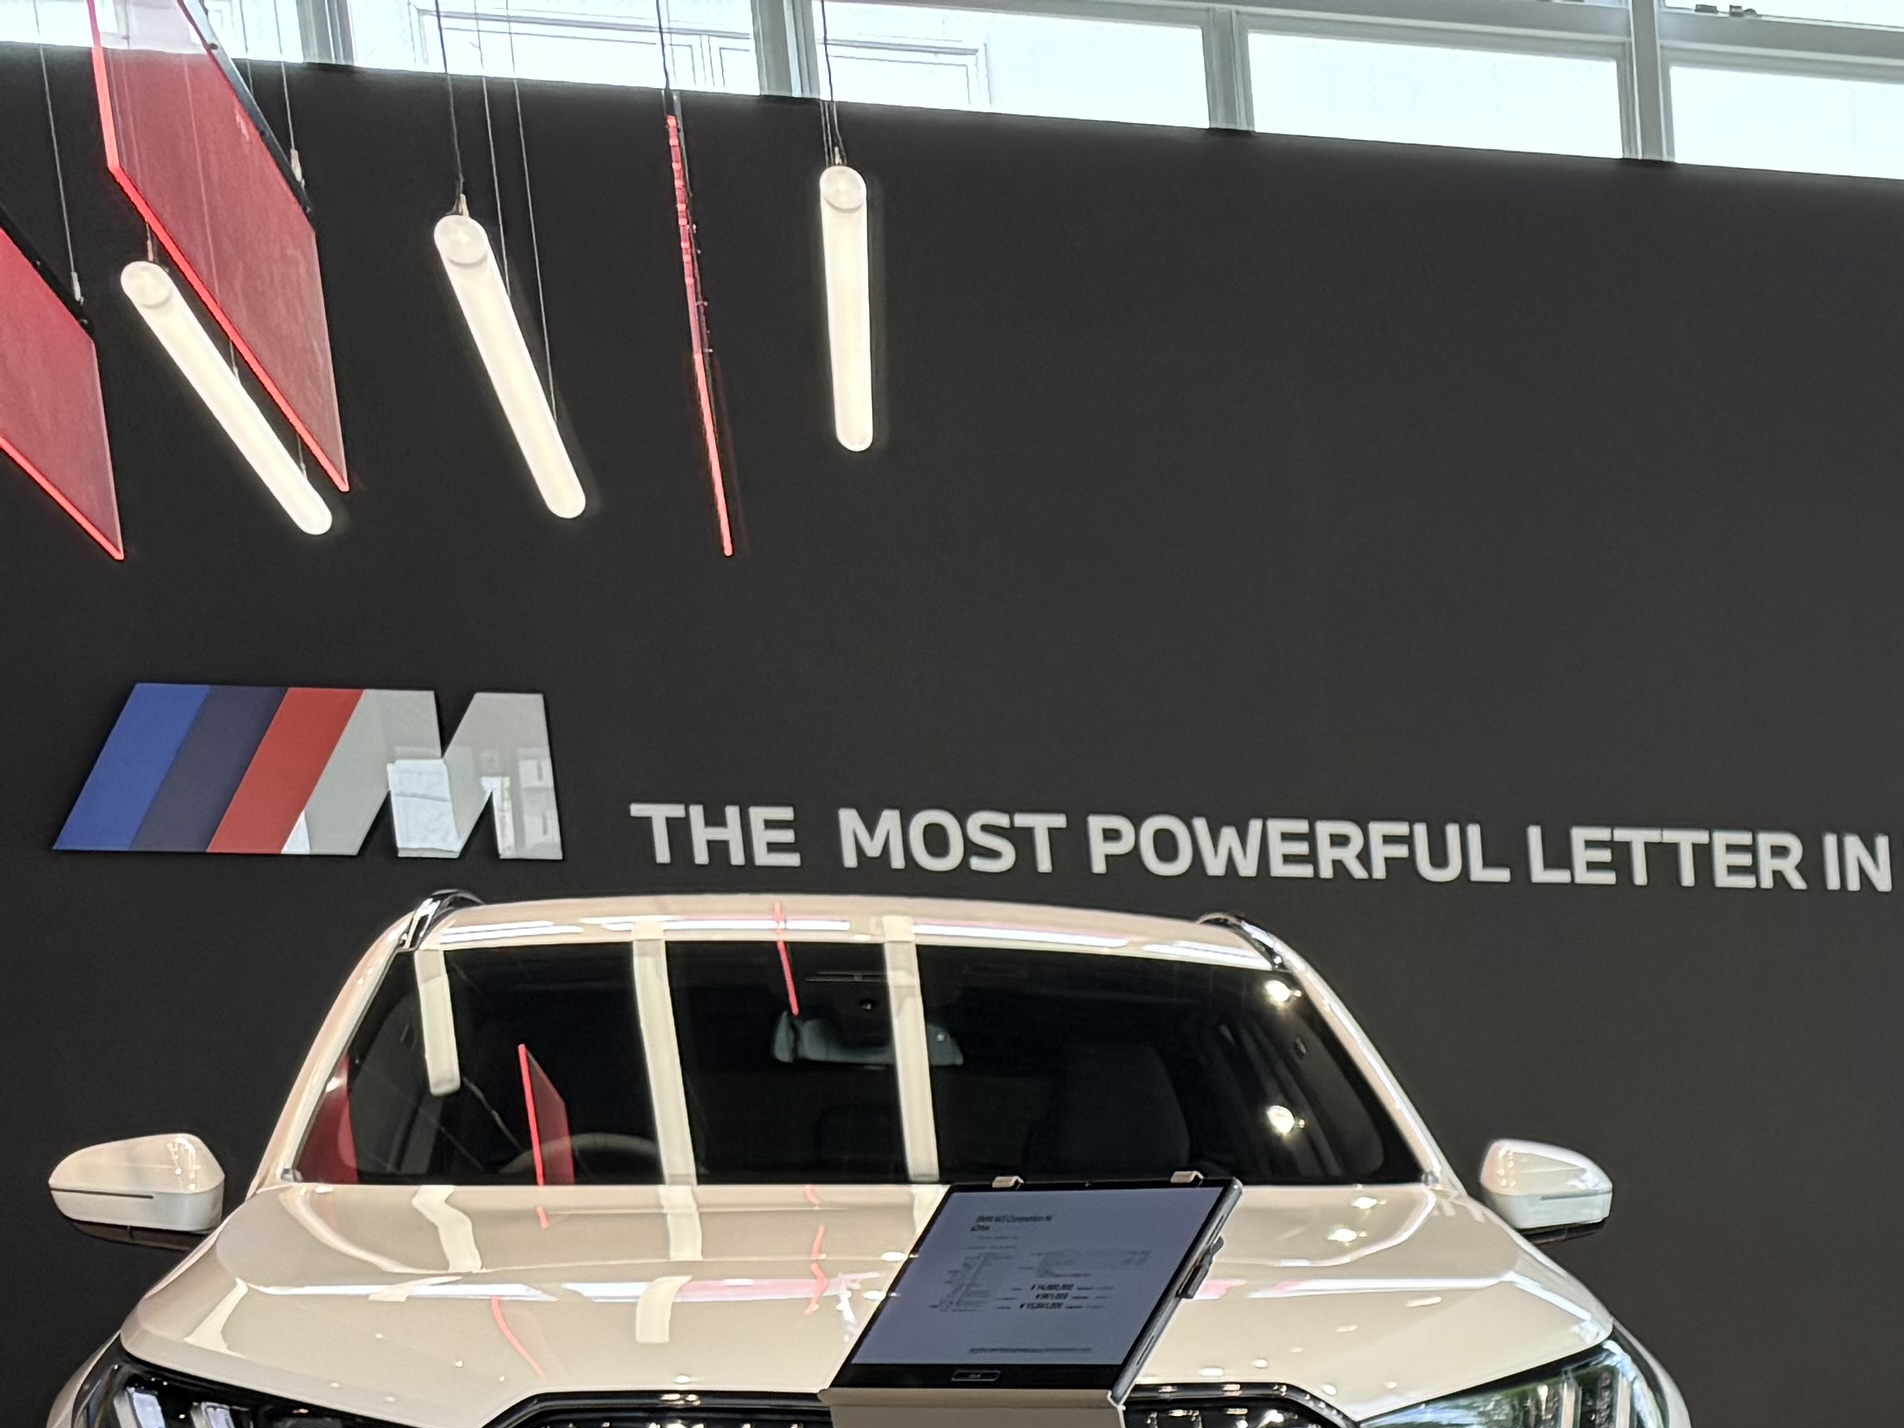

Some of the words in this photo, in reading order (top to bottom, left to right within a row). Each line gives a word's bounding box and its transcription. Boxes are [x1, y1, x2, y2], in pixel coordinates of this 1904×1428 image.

[630, 803, 801, 867] THE
[838, 808, 1067, 873] MOST
[1086, 814, 1511, 883] POWERFUL
[1526, 825, 1808, 890] LETTER
[1822, 832, 1893, 893] IN
